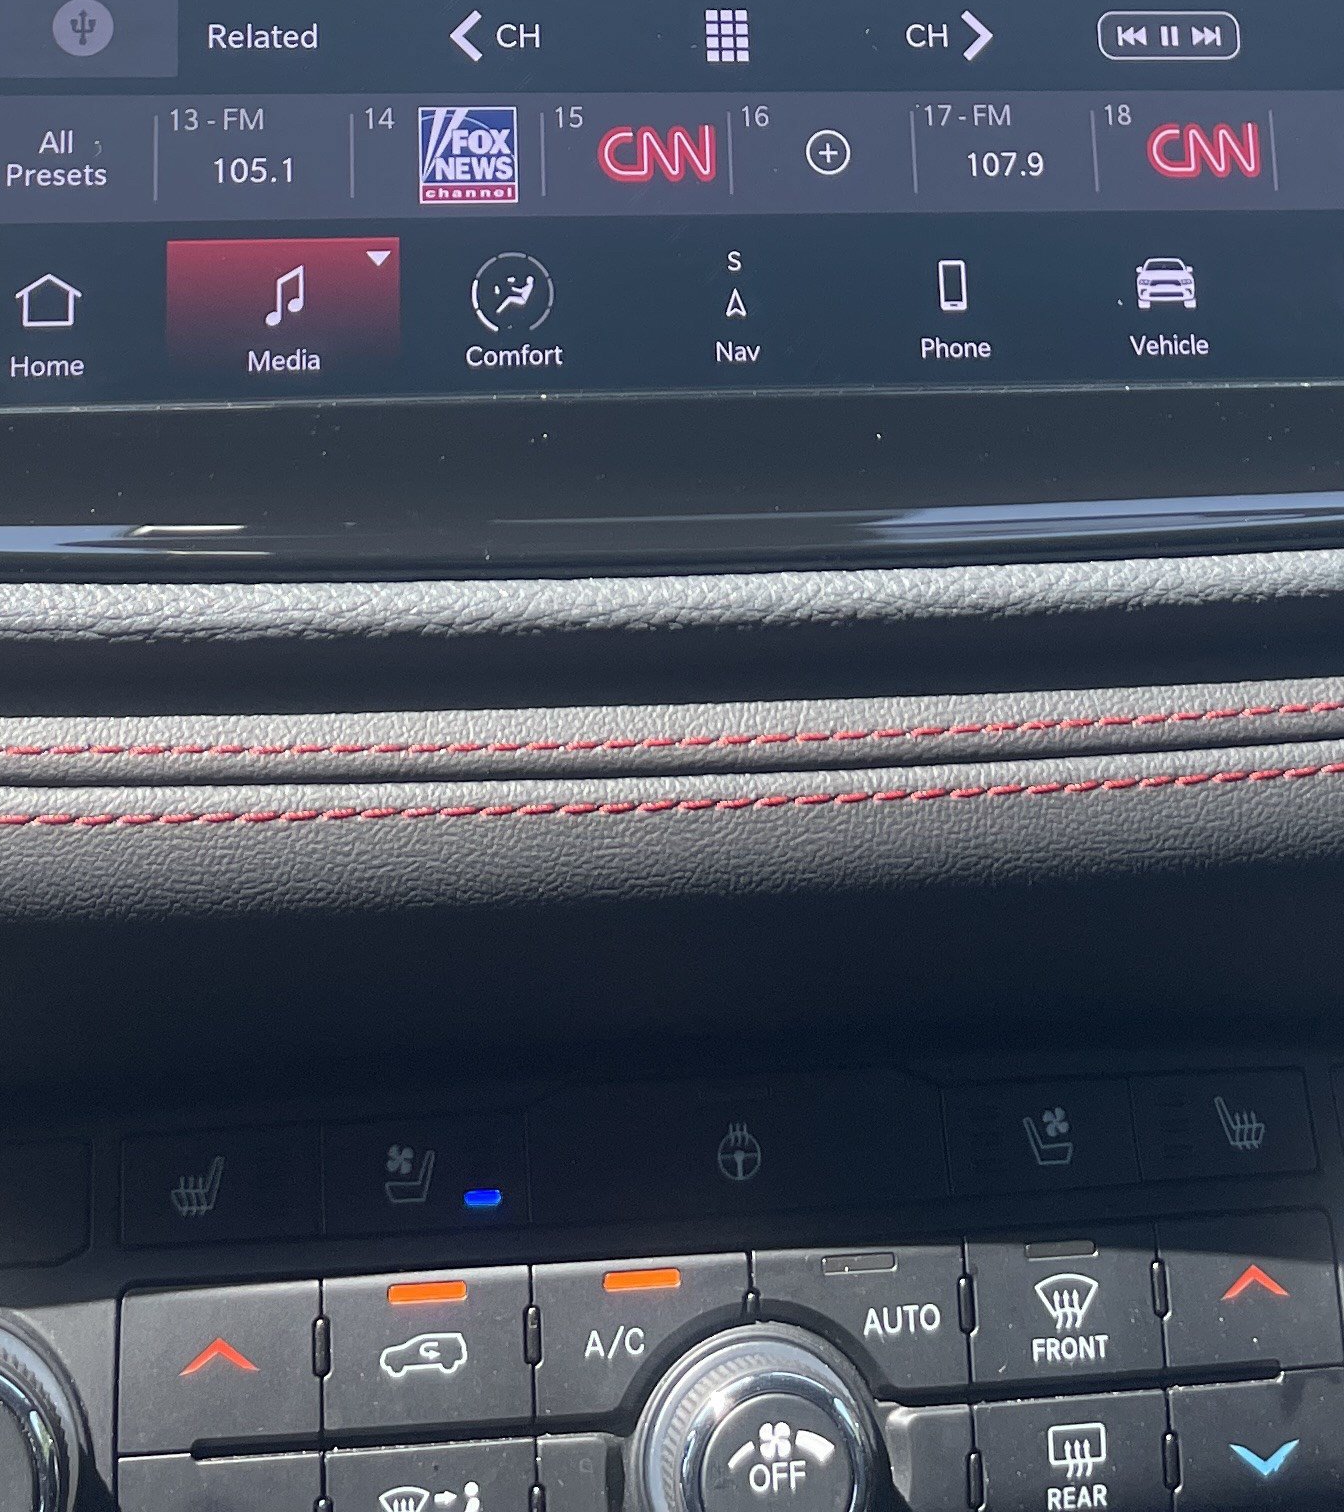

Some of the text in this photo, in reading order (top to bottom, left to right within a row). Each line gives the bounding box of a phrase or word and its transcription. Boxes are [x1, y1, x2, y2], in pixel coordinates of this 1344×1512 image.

[206, 21, 320, 52] Related
[495, 21, 542, 50] CH
[905, 21, 949, 50] CH
[169, 106, 200, 132] 13
[221, 106, 266, 132] FM
[364, 106, 397, 132] 14
[554, 105, 585, 130] 15
[740, 104, 771, 129] 16
[924, 104, 952, 128] 17
[972, 103, 1013, 128] FM
[1103, 103, 1133, 128] 18
[39, 129, 75, 157] All
[451, 128, 512, 158] FOX
[596, 125, 718, 183] CNN
[1146, 122, 1261, 179] CNN
[5, 162, 108, 190] Presets
[212, 155, 296, 186] 105.1
[432, 154, 516, 184] NEWS
[965, 151, 1046, 180] 107.9
[423, 187, 515, 200] channel
[726, 250, 743, 273] S
[464, 344, 565, 370] Comfort
[714, 339, 763, 364] Nav
[919, 336, 993, 362] Phone
[1128, 333, 1211, 359] Vehicle
[8, 354, 87, 380] Home
[246, 348, 323, 374] Media
[862, 1302, 942, 1337] AUTO
[583, 1326, 647, 1361] A/C
[1031, 1334, 1110, 1363] FRONT
[748, 1459, 807, 1493] OFF
[1046, 1484, 1109, 1511] REAR
